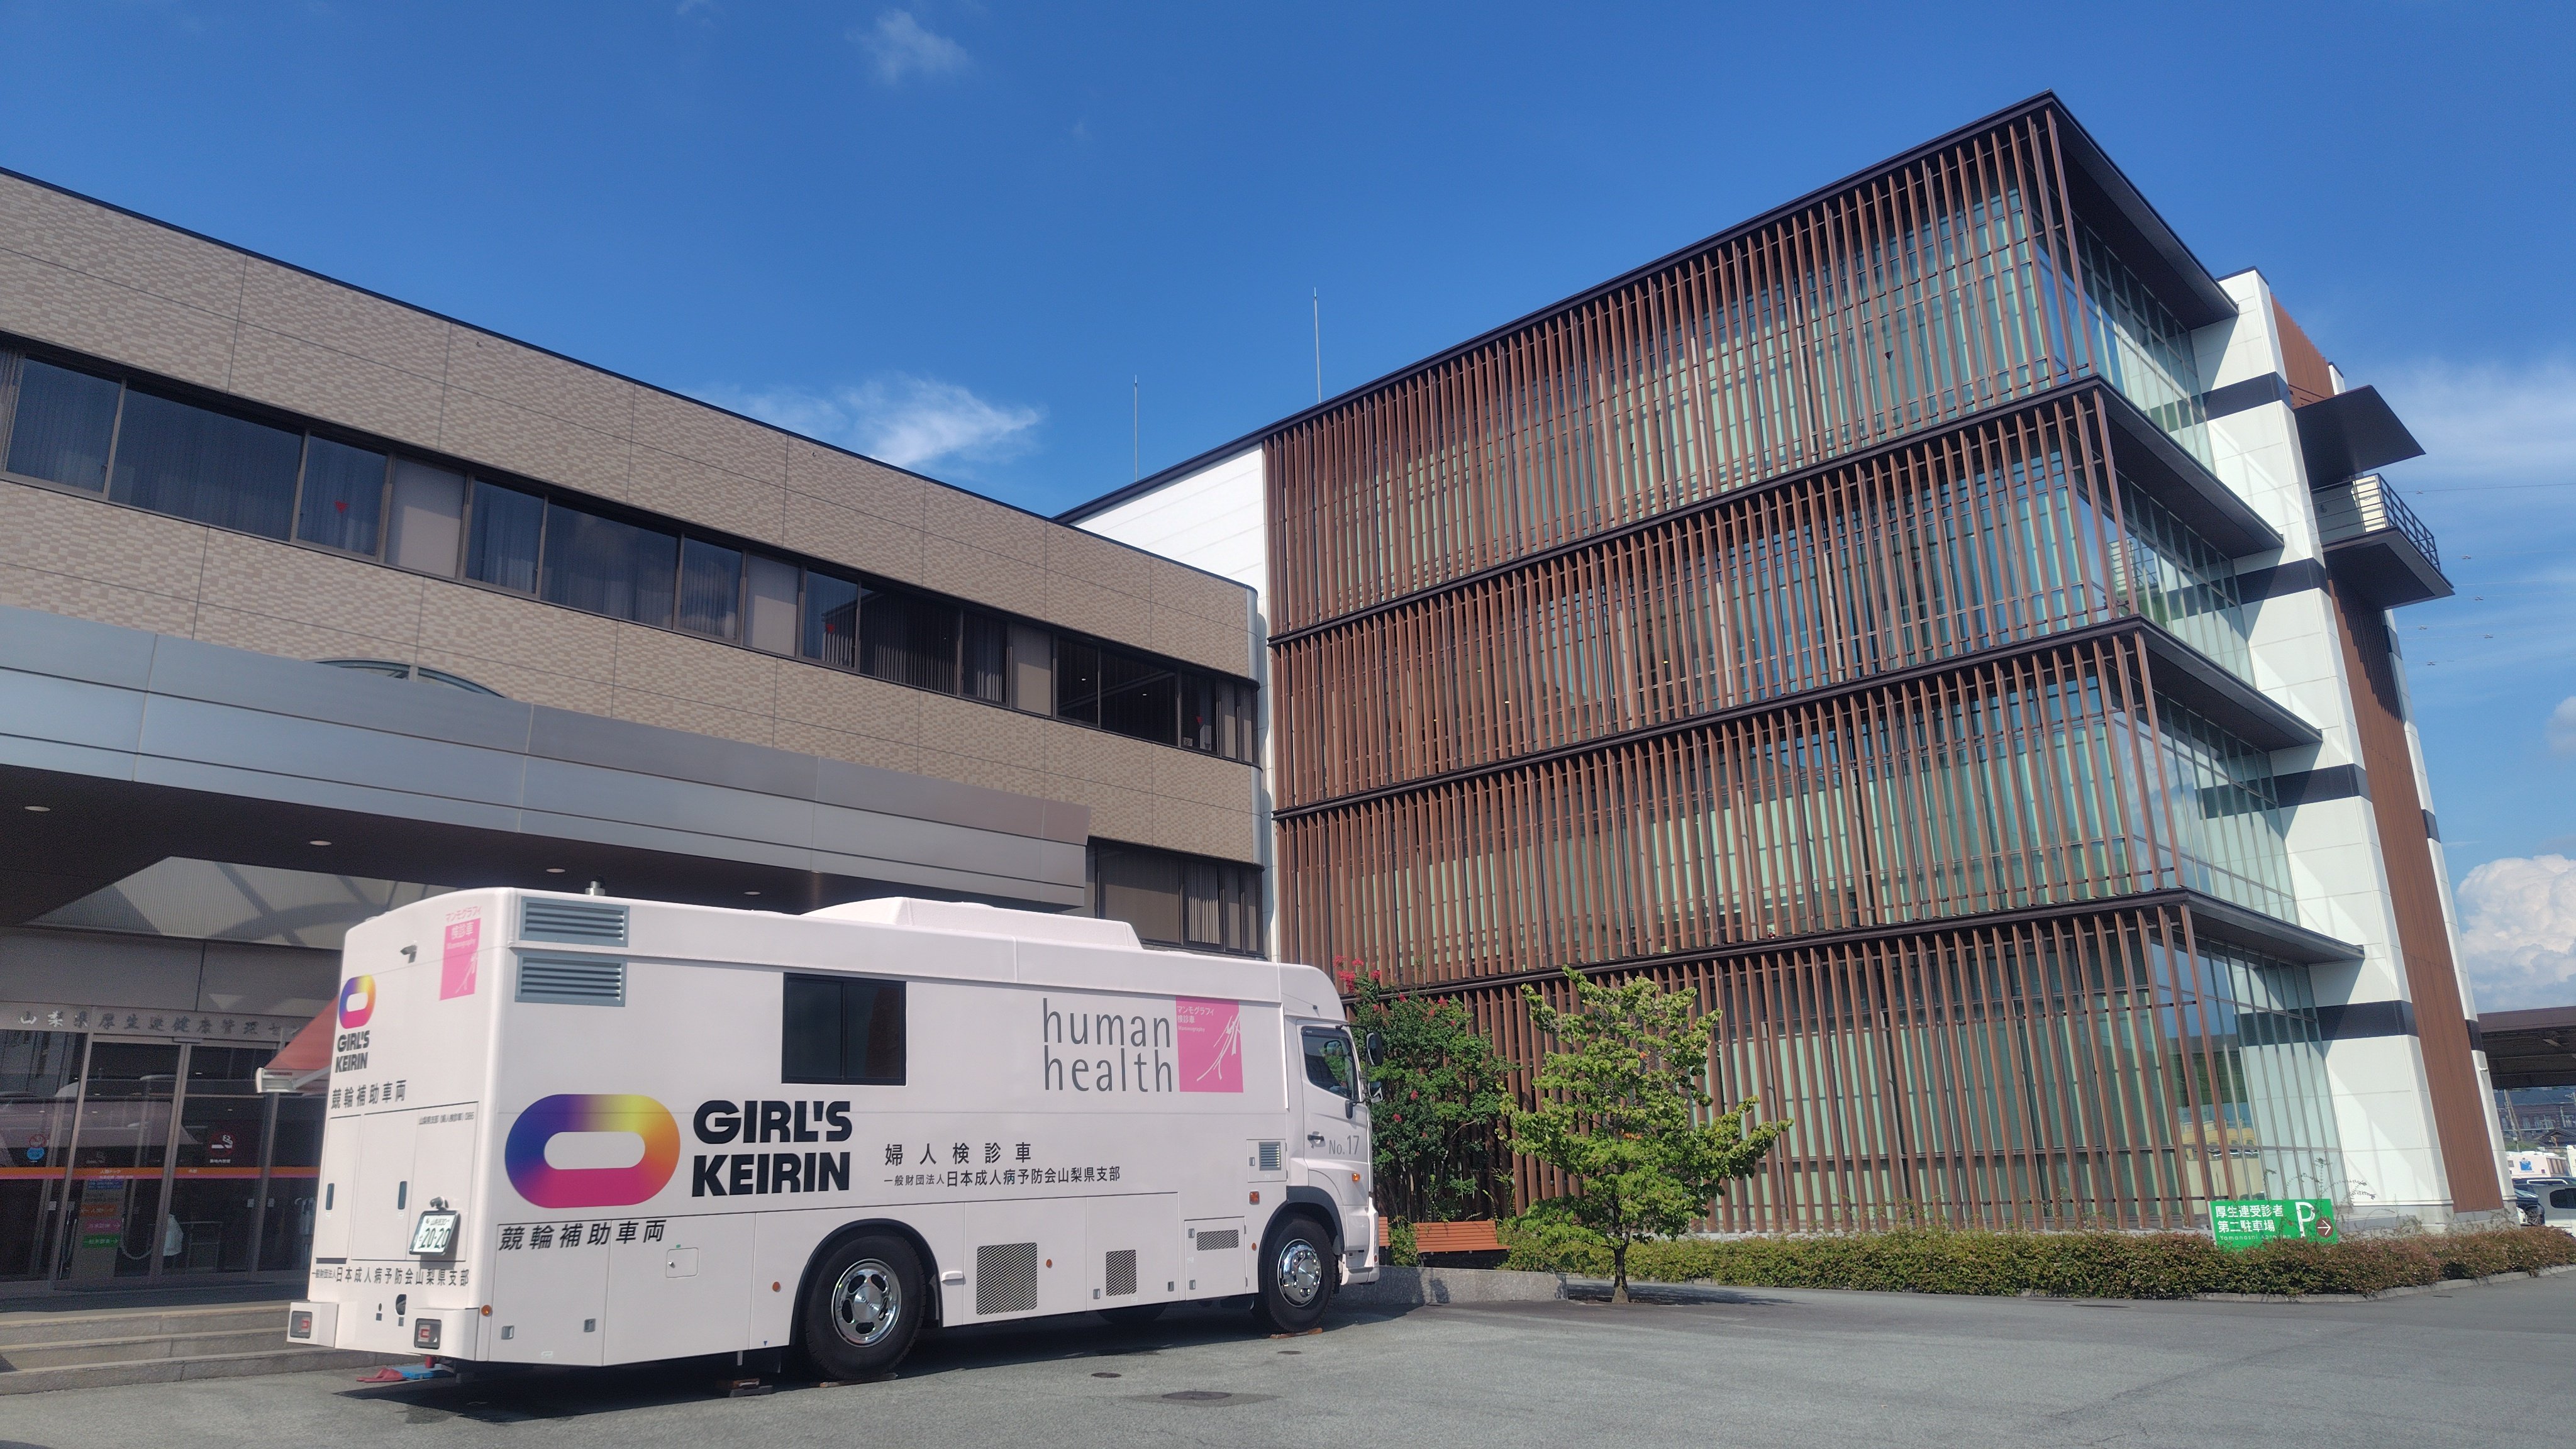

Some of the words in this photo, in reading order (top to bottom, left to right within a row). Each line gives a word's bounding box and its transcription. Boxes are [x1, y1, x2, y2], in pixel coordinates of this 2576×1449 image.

[1043, 997, 1170, 1048] human
[1177, 1006, 1214, 1016] マンモグラフィ
[337, 1030, 370, 1052] GIRL'S
[335, 1052, 368, 1073] KEIRIN
[1044, 1045, 1172, 1092] health
[331, 1080, 406, 1109] 競輪補助車両
[693, 1100, 852, 1145] GIRL'S
[885, 1142, 1031, 1167] 婦人検診車
[692, 1152, 850, 1197] KEIRIN
[2215, 1204, 2284, 1218] 厚生連受診者
[2296, 1201, 2316, 1238] P
[498, 1219, 667, 1251] 競輪補助車両
[2217, 1219, 2275, 1233] 第二駐車場
